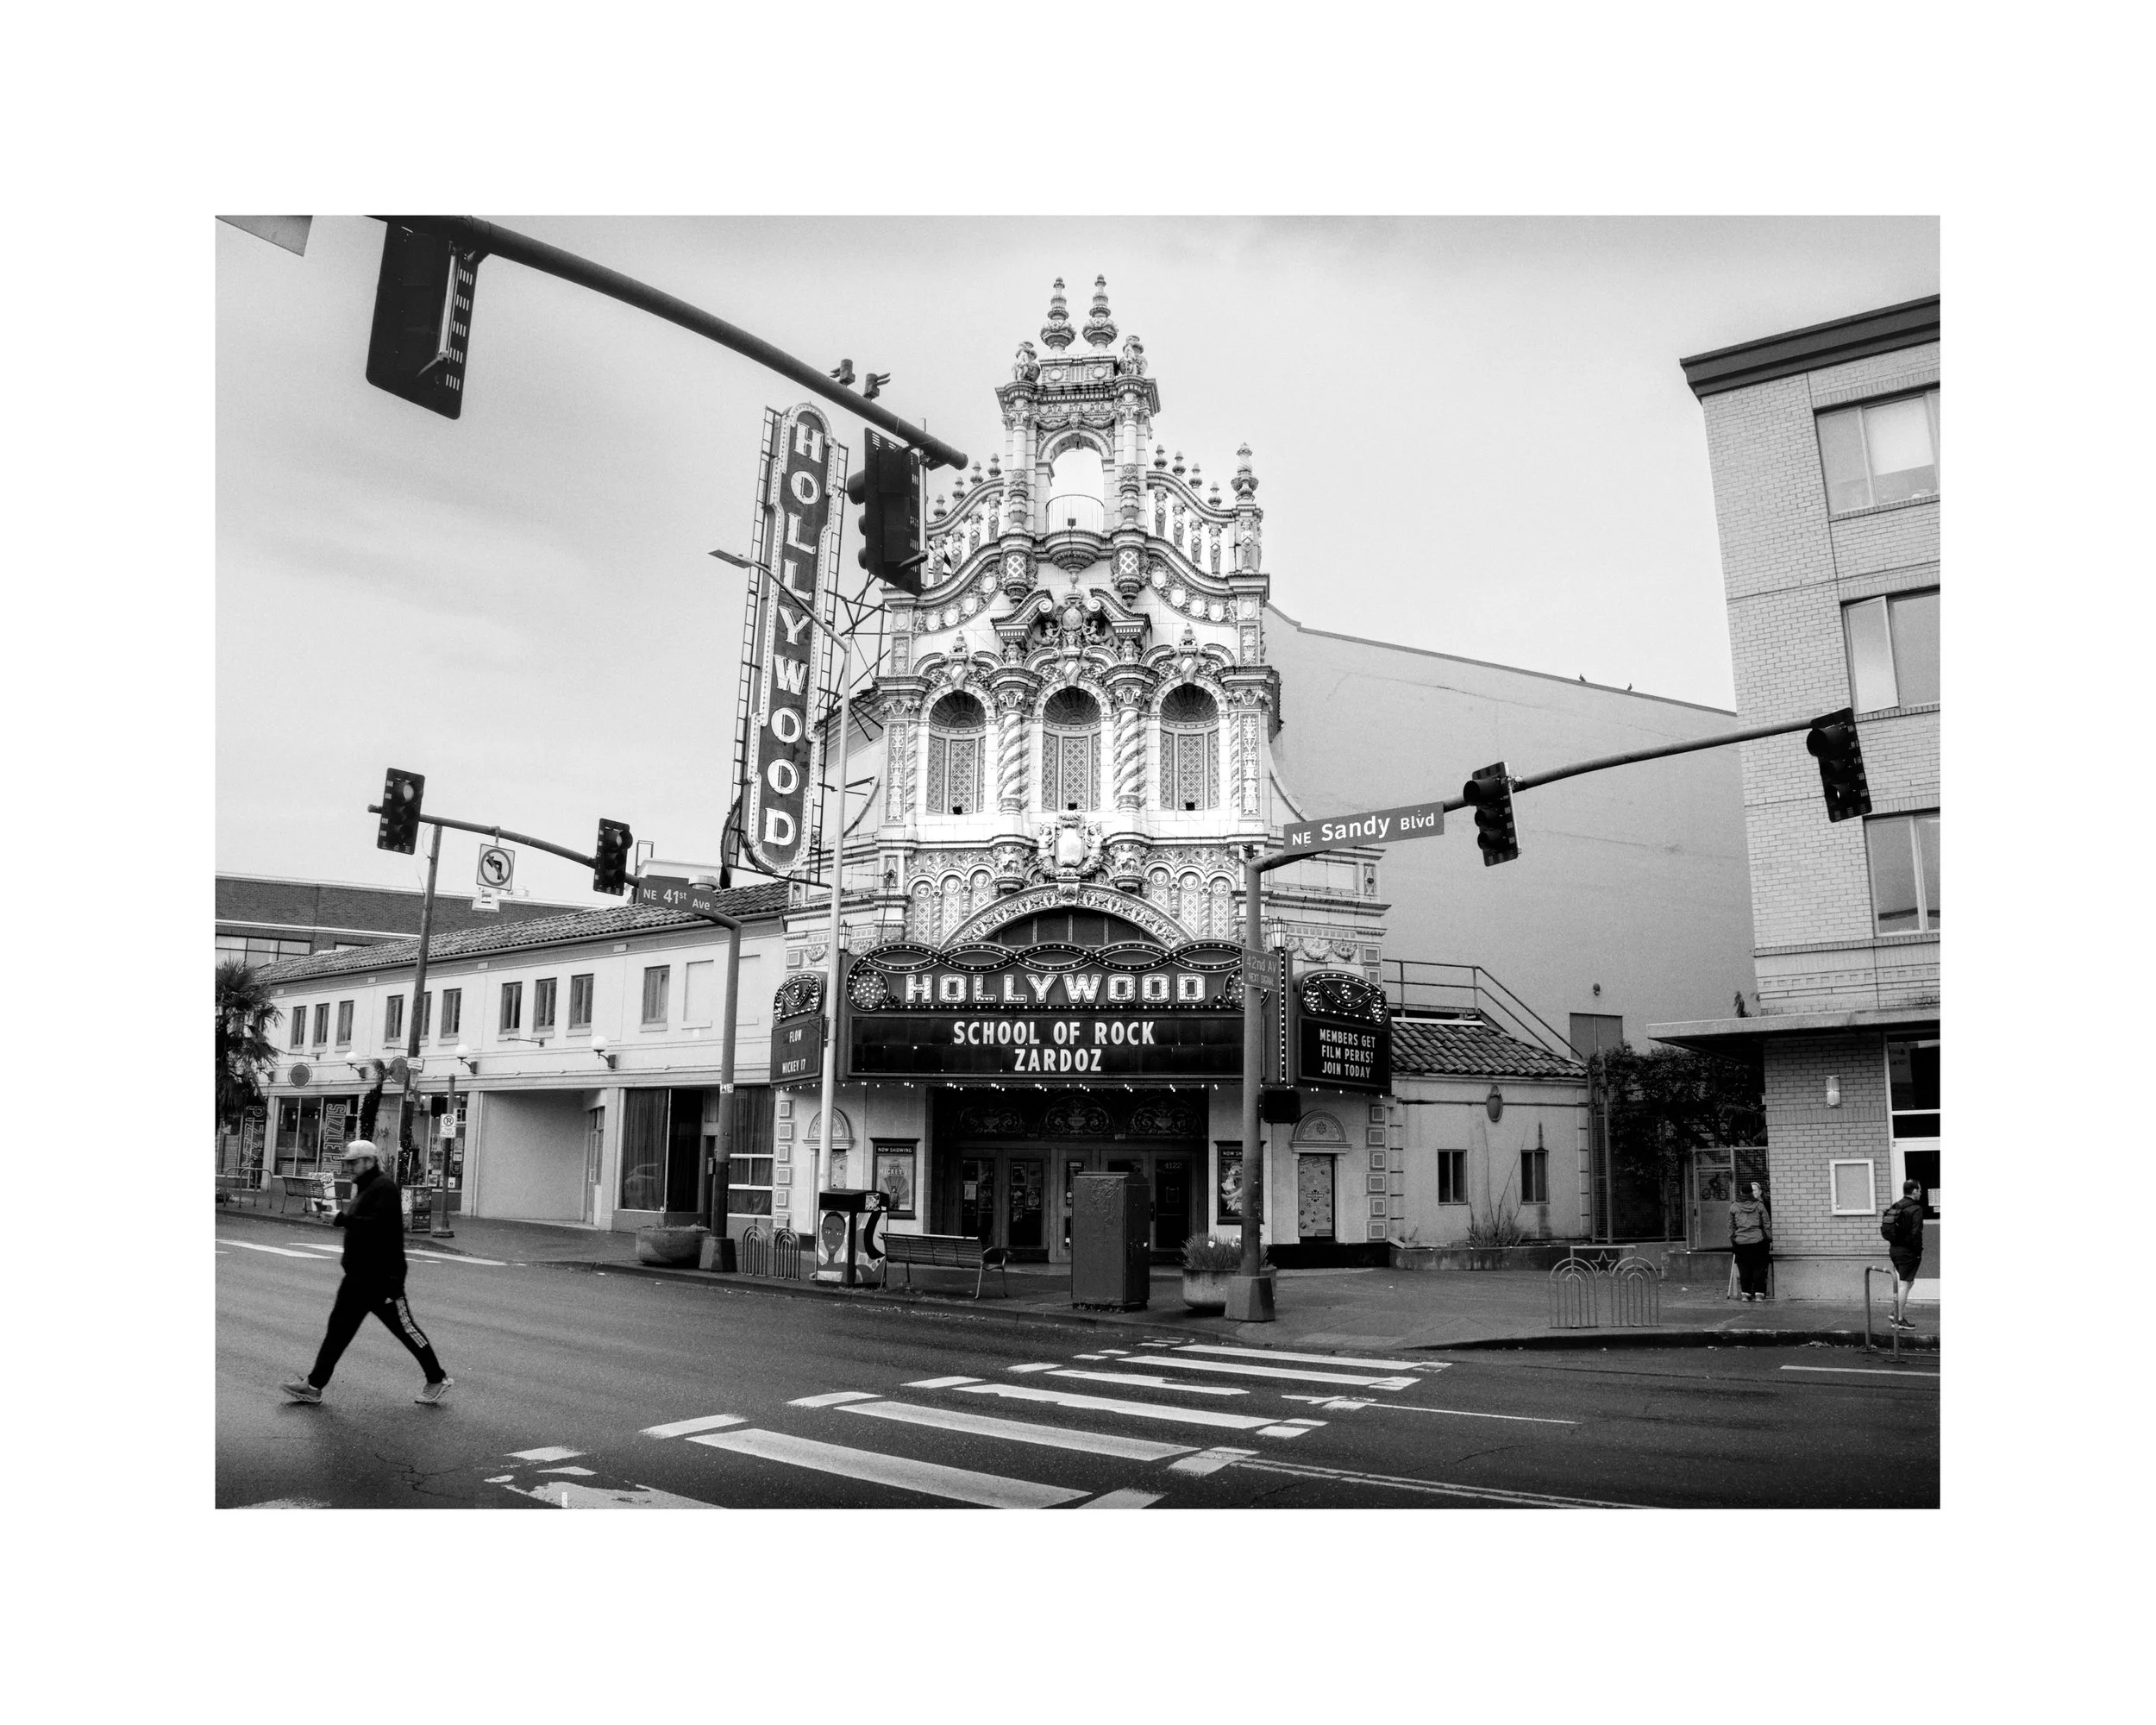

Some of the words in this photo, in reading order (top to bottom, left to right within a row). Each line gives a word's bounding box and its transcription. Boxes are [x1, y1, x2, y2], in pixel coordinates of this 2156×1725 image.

[763, 421, 824, 847] HOLLYWOOD
[1292, 831, 1312, 847] NE
[1321, 815, 1390, 838] Sandy
[1400, 812, 1434, 831] Blvd
[643, 888, 657, 900] NE
[663, 888, 687, 905] 41st
[692, 898, 711, 911] Ave
[1246, 955, 1266, 971] 42nd
[1267, 960, 1277, 973] AV
[905, 973, 1206, 1005] HOLLYWOOD
[789, 1029, 802, 1043] FLOW
[953, 1020, 1040, 1046] SCHOOL
[1053, 1020, 1081, 1044] OF
[1094, 1021, 1155, 1045] ROCK
[1319, 1028, 1358, 1046] MEMBERS
[1361, 1035, 1376, 1048] GET
[1014, 1048, 1102, 1072] ZARDOZ
[1321, 1044, 1341, 1059] FILM
[1344, 1048, 1374, 1063] PERKS!
[782, 1060, 799, 1074] MICKEY
[1322, 1061, 1341, 1076] JOIN
[1344, 1063, 1370, 1079] TODAY
[323, 1103, 347, 1151] SIZZLE
